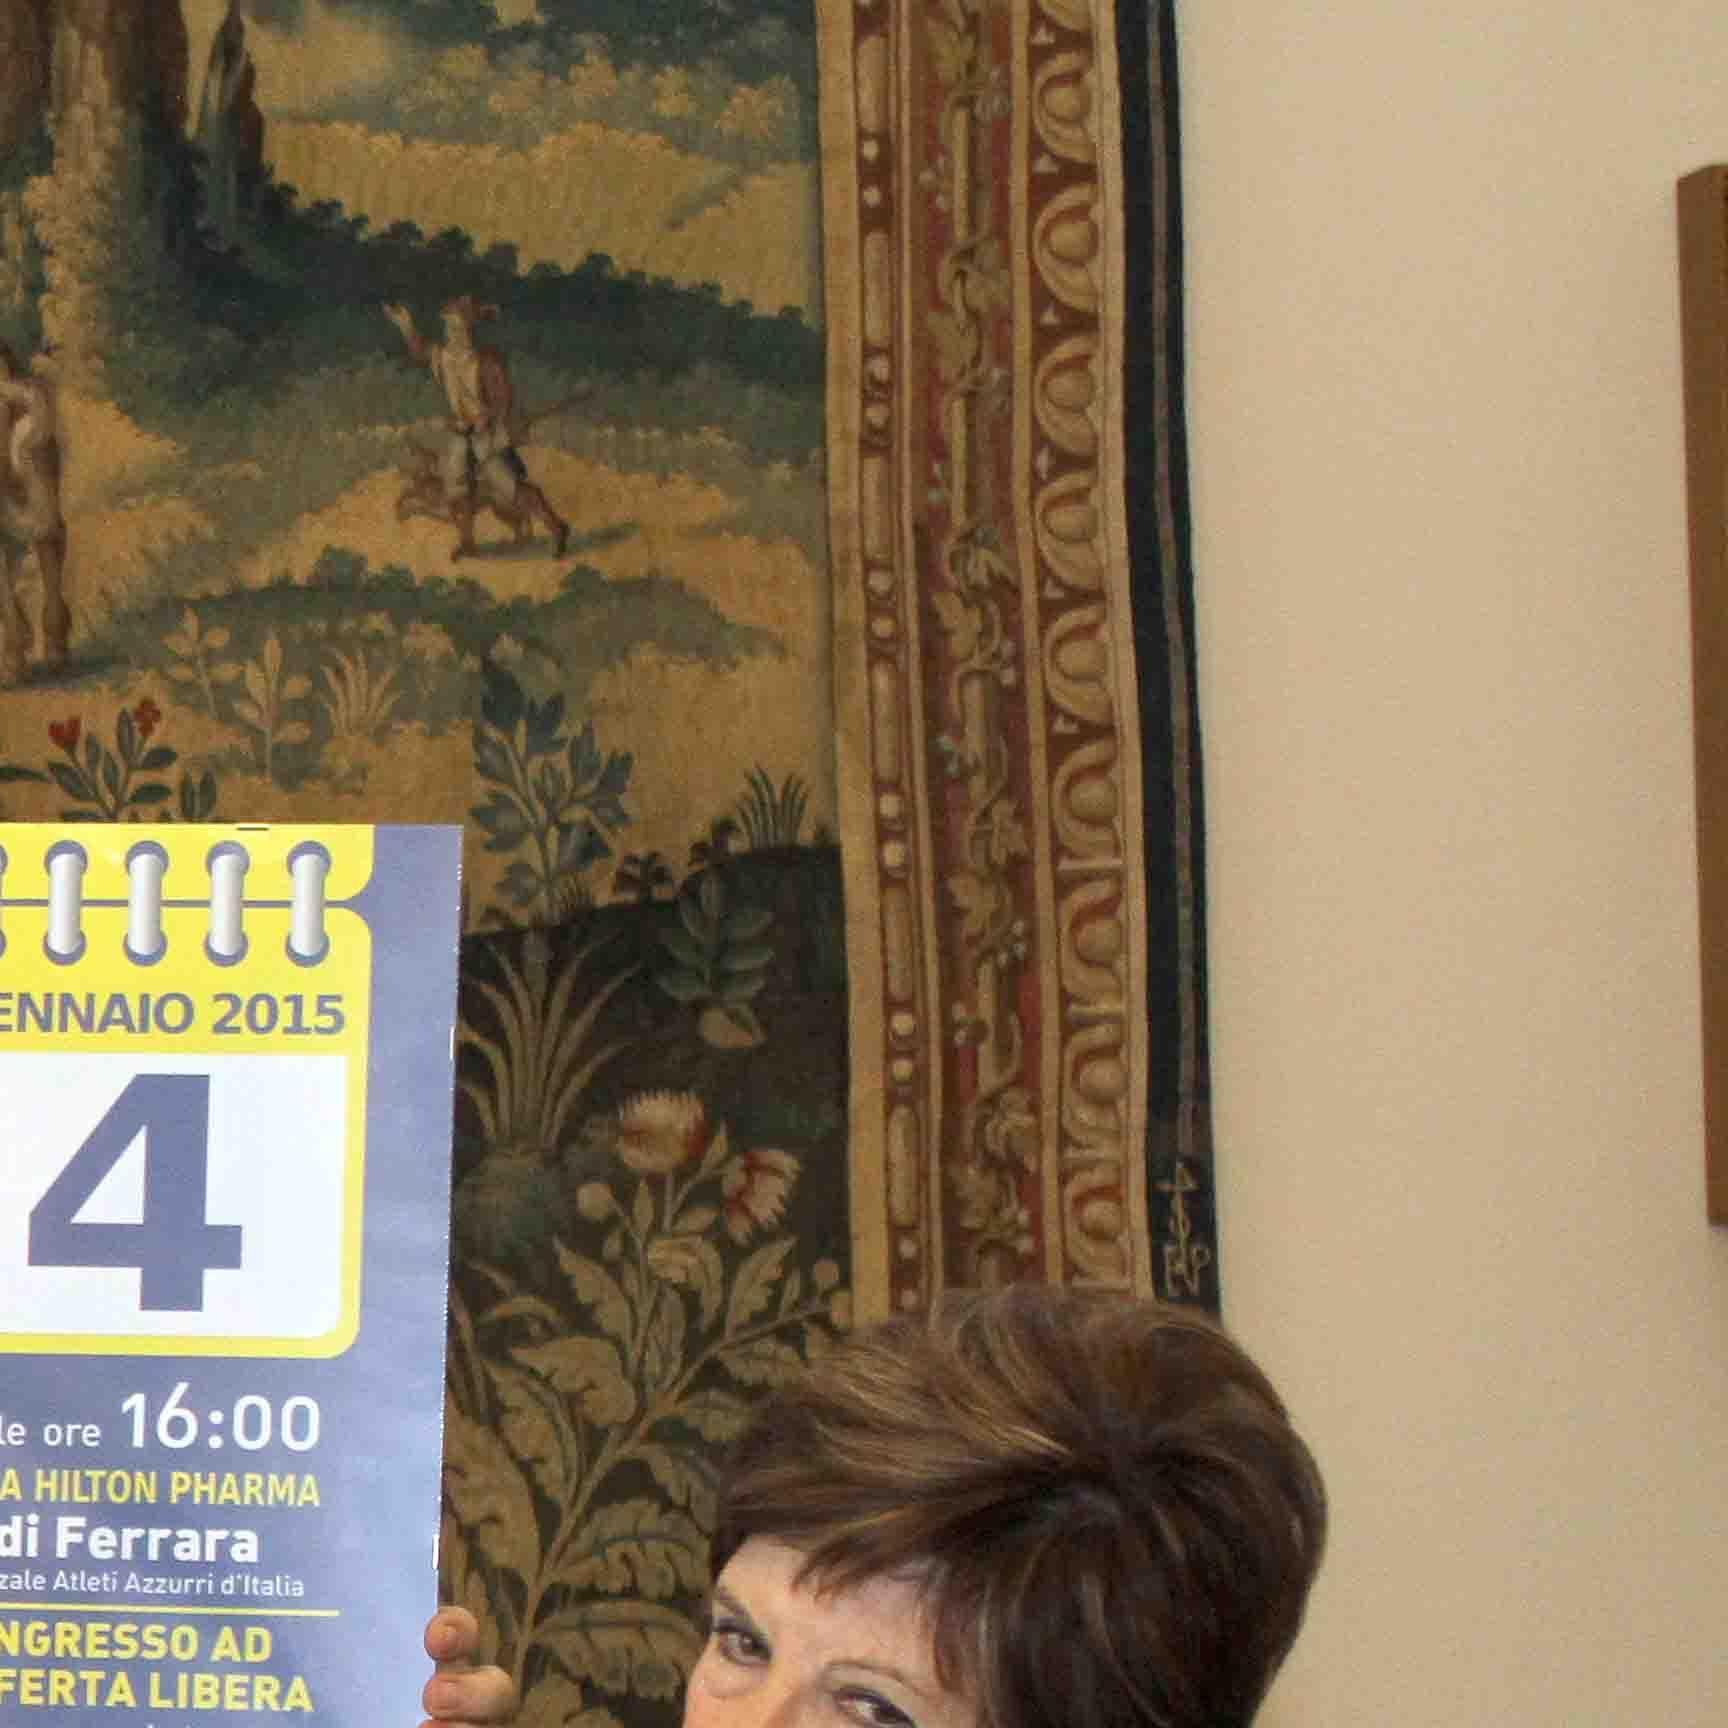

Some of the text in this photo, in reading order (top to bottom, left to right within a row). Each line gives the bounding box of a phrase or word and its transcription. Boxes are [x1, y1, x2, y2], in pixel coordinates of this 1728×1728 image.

[211, 993, 345, 1036] 2015
[28, 1073, 242, 1312] 4
[43, 1420, 101, 1448] ore
[121, 1381, 321, 1452] 16:00
[34, 1469, 157, 1504] HILTON
[169, 1472, 321, 1507] PHARMA
[55, 1516, 259, 1563] Ferrara
[53, 1570, 119, 1594] Atleti
[124, 1572, 215, 1596] Azzurri
[221, 1573, 305, 1598] d'Italia
[210, 1626, 273, 1664] AD
[148, 1673, 315, 1713] LIBERA
